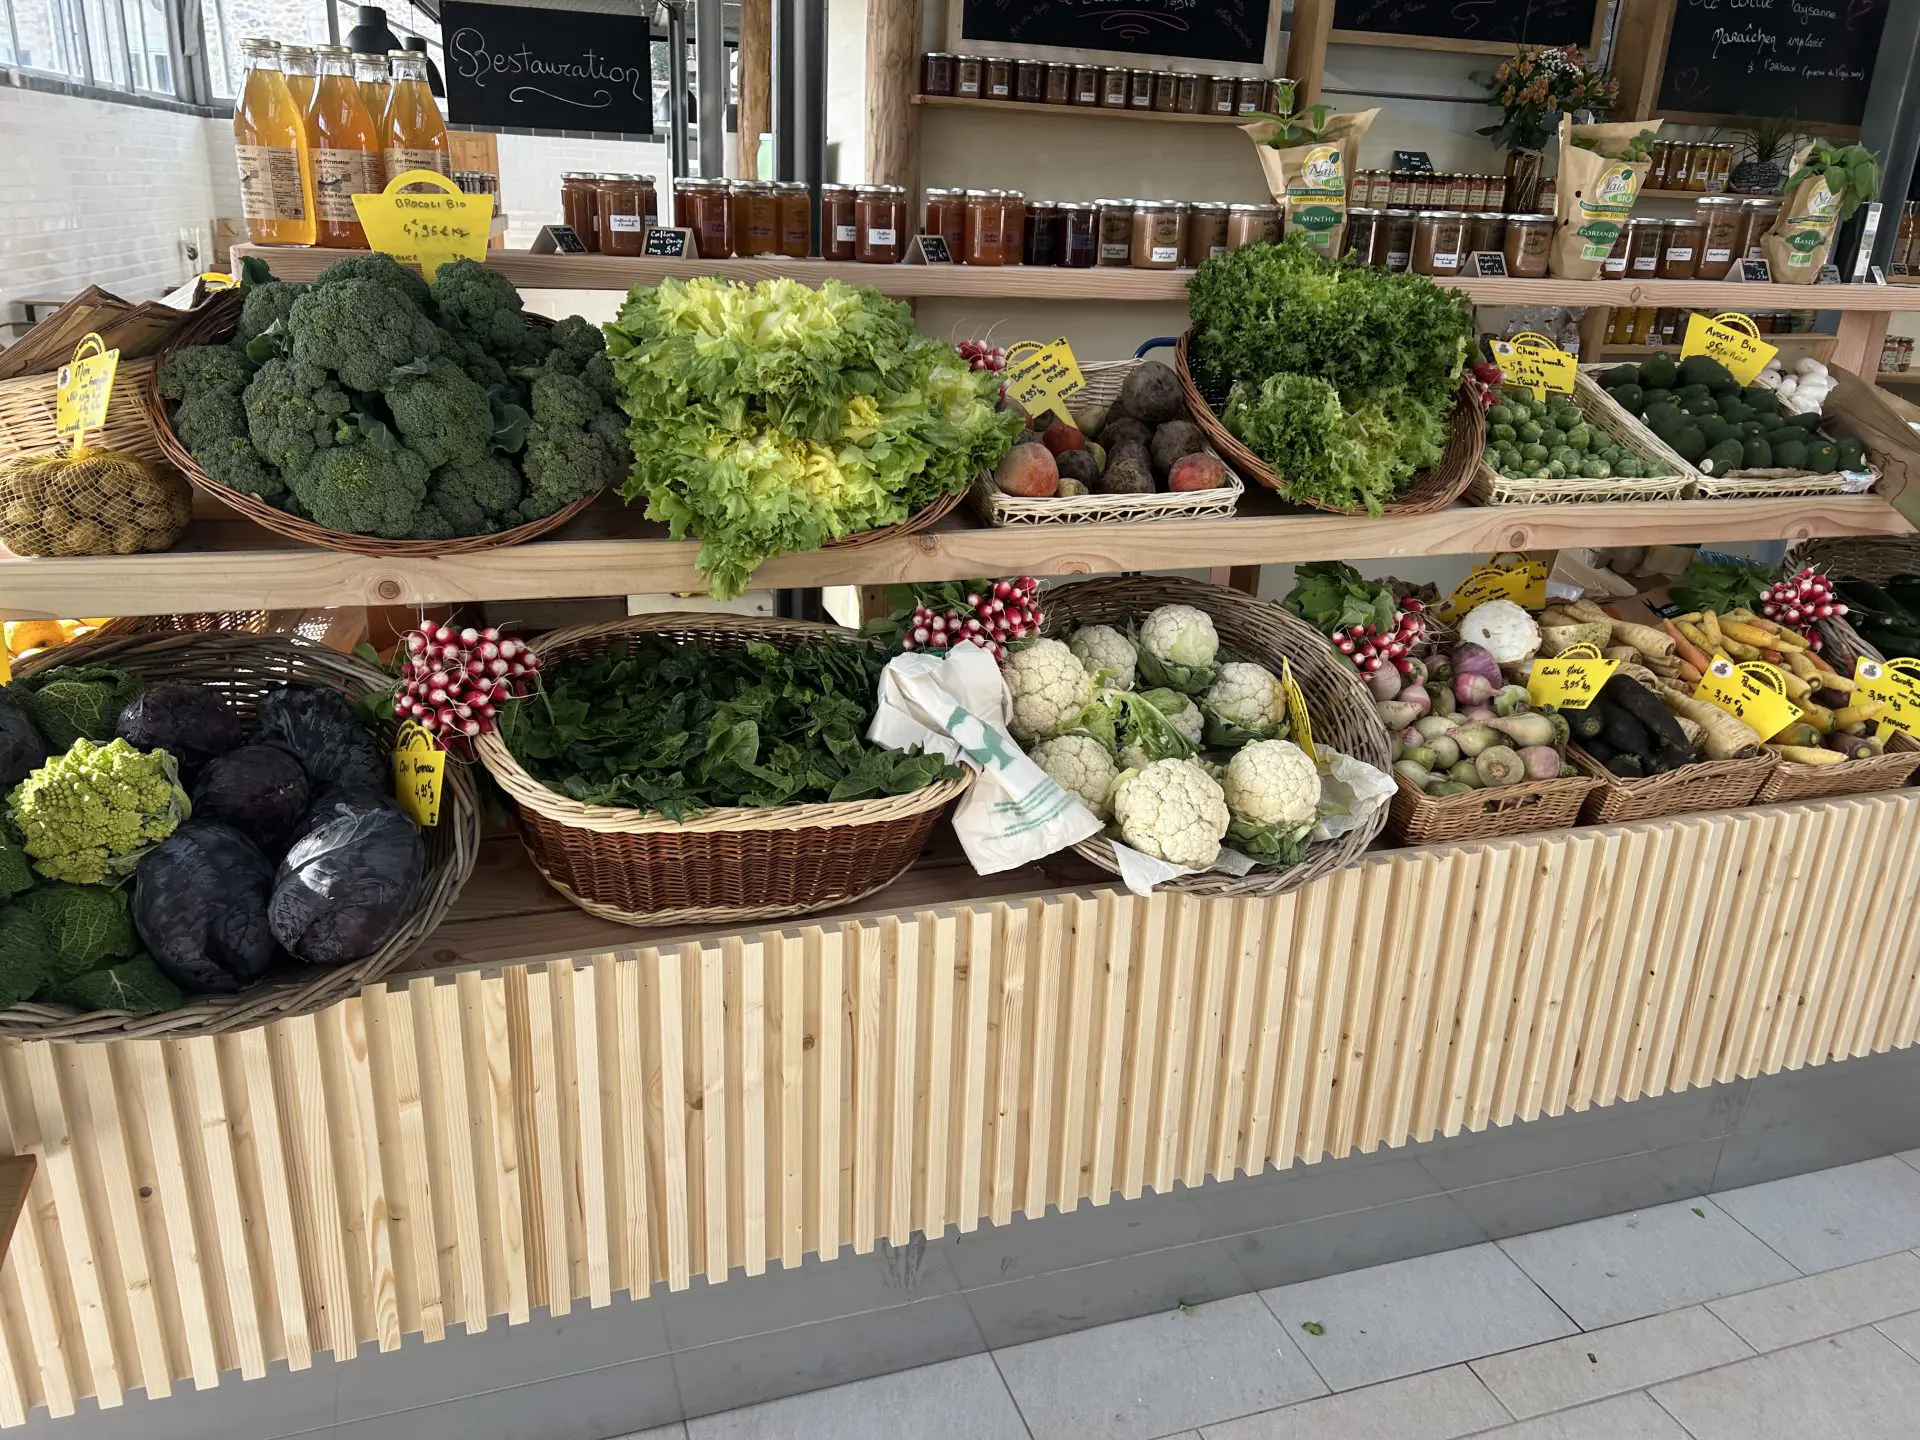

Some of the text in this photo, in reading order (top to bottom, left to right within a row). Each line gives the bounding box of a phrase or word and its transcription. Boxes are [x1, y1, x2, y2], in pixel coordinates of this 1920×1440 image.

[450, 28, 644, 101] Restauration
[395, 198, 467, 210] BROCOLI BIO
[1301, 215, 1336, 223] MENTHE
[1541, 666, 1561, 675] Radis
[1765, 666, 1783, 695] producteurs
[1882, 716, 1912, 731] FRANCE
